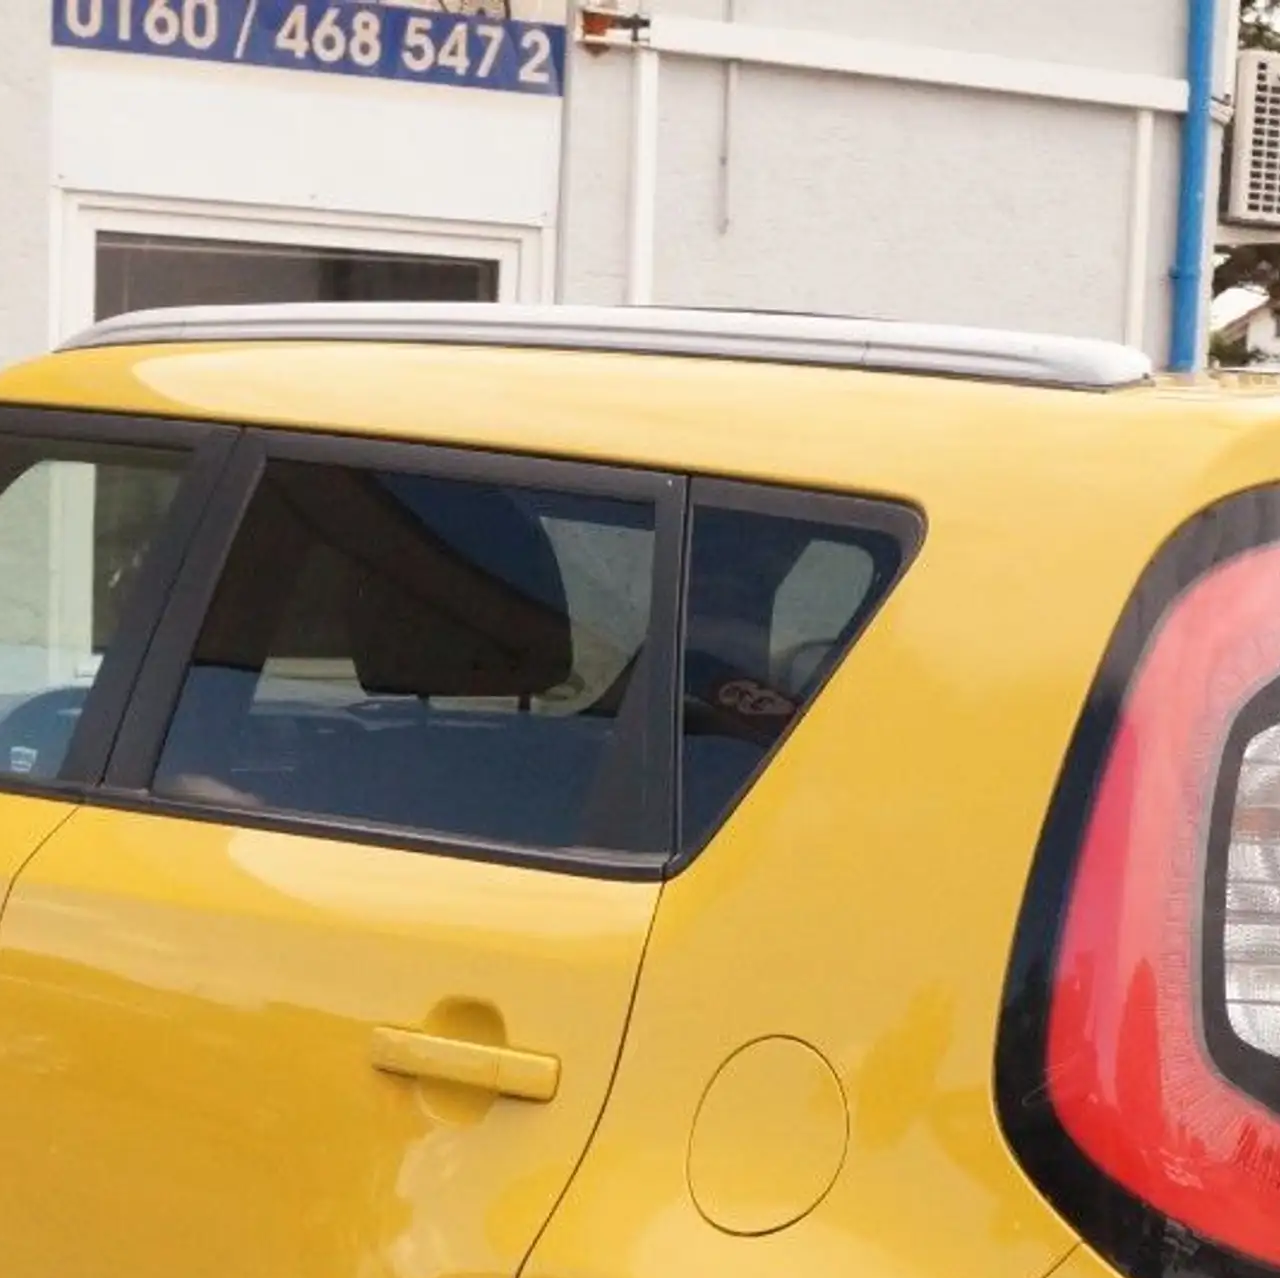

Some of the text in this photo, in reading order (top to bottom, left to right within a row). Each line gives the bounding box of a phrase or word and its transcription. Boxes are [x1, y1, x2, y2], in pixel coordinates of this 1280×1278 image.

[65, 0, 217, 51] 0160
[275, 4, 382, 67] 468
[402, 17, 507, 79] 547
[519, 30, 552, 83] 2
